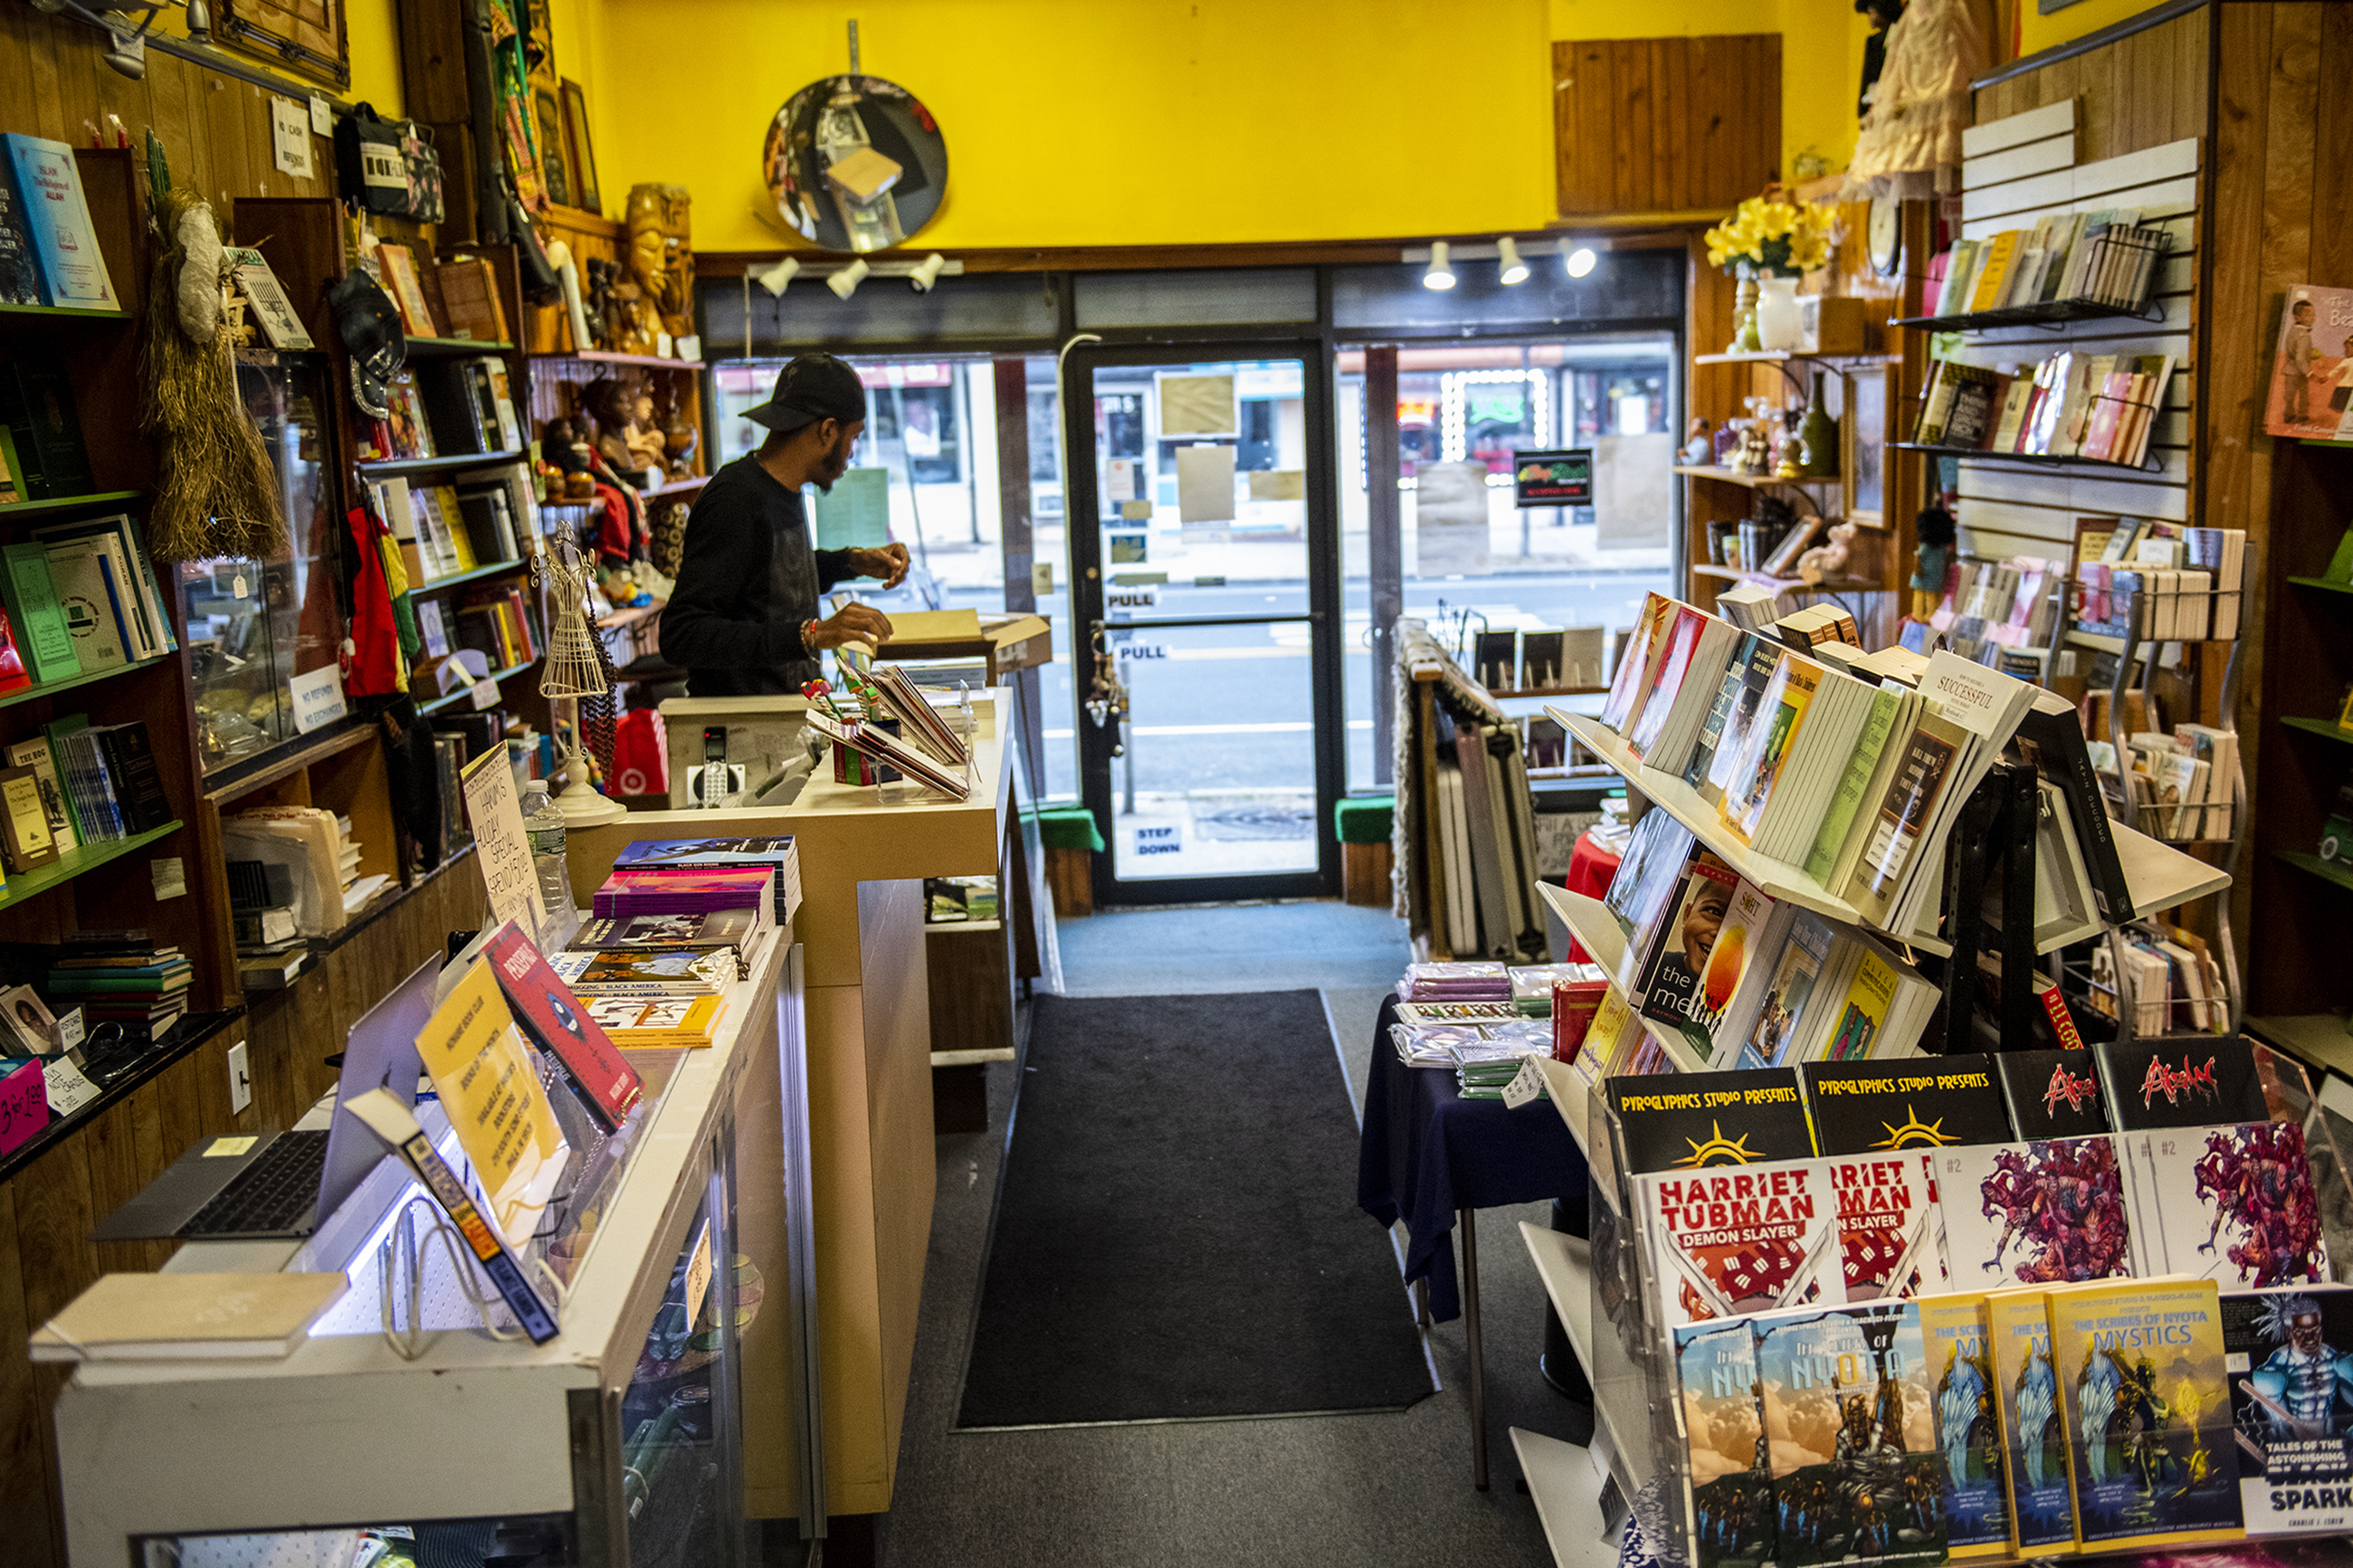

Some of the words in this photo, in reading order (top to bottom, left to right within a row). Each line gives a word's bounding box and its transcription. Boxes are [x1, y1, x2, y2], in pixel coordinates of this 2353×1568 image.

[277, 119, 286, 133] NO
[289, 124, 303, 137] CASH
[46, 191, 65, 202] ALLAH
[118, 556, 129, 585] KORAN
[1109, 594, 1155, 607] PULL
[1120, 646, 1166, 659] PULL
[1937, 675, 1993, 709] SUCCESSFUL
[19, 753, 32, 764] THE
[32, 748, 46, 759] HOG
[1911, 746, 1923, 762] KILL
[481, 775, 508, 815] HAKIM'S
[474, 814, 501, 853] HOLIDAY
[1138, 827, 1172, 839] STEP
[491, 830, 519, 865] SPECIAL
[1138, 843, 1180, 855] DOWN
[488, 865, 512, 898] SPEND
[503, 942, 538, 981] PERSEPOLIS
[570, 955, 595, 976] AMERICA
[1662, 965, 1691, 988] the
[543, 1050, 573, 1082] PERSEPOLIS
[48, 1077, 68, 1092] NOTE
[62, 1075, 86, 1093] CARDS
[1818, 1079, 1896, 1096] PYROGLYPHICS
[1897, 1076, 1934, 1092] STUDIO
[1938, 1072, 1990, 1090] PRESENTS
[1621, 1092, 1700, 1112] PYROGLYPHICS
[1703, 1089, 1741, 1107] STUDIO
[1744, 1087, 1798, 1105] PRESENTS
[0, 1099, 12, 1135] 3
[2161, 1140, 2176, 1156] #2
[1947, 1158, 1962, 1174] #2
[1658, 1169, 1810, 1208] HARRIET
[1661, 1194, 1815, 1232] TUBMAN
[1849, 1213, 1899, 1231] SLAYER
[1682, 1230, 1740, 1247] DEMON
[1742, 1223, 1797, 1241] SLAYER
[2012, 1324, 2033, 1335] THE
[2073, 1319, 2095, 1332] THE
[2095, 1315, 2142, 1330] SCRIBES
[2143, 1312, 2161, 1326] OF
[2163, 1309, 2208, 1324] NYOTA
[1873, 1335, 1888, 1349] OF
[1934, 1326, 1957, 1338] THE
[2092, 1324, 2193, 1351] MYSTICS
[1790, 1349, 1907, 1391] NYOTA
[2265, 1440, 2301, 1453] TALES
[2301, 1440, 2318, 1452] OF
[2319, 1438, 2344, 1450] THE
[2267, 1451, 2346, 1466] ASTONISHING
[2270, 1487, 2353, 1512] SPARK
